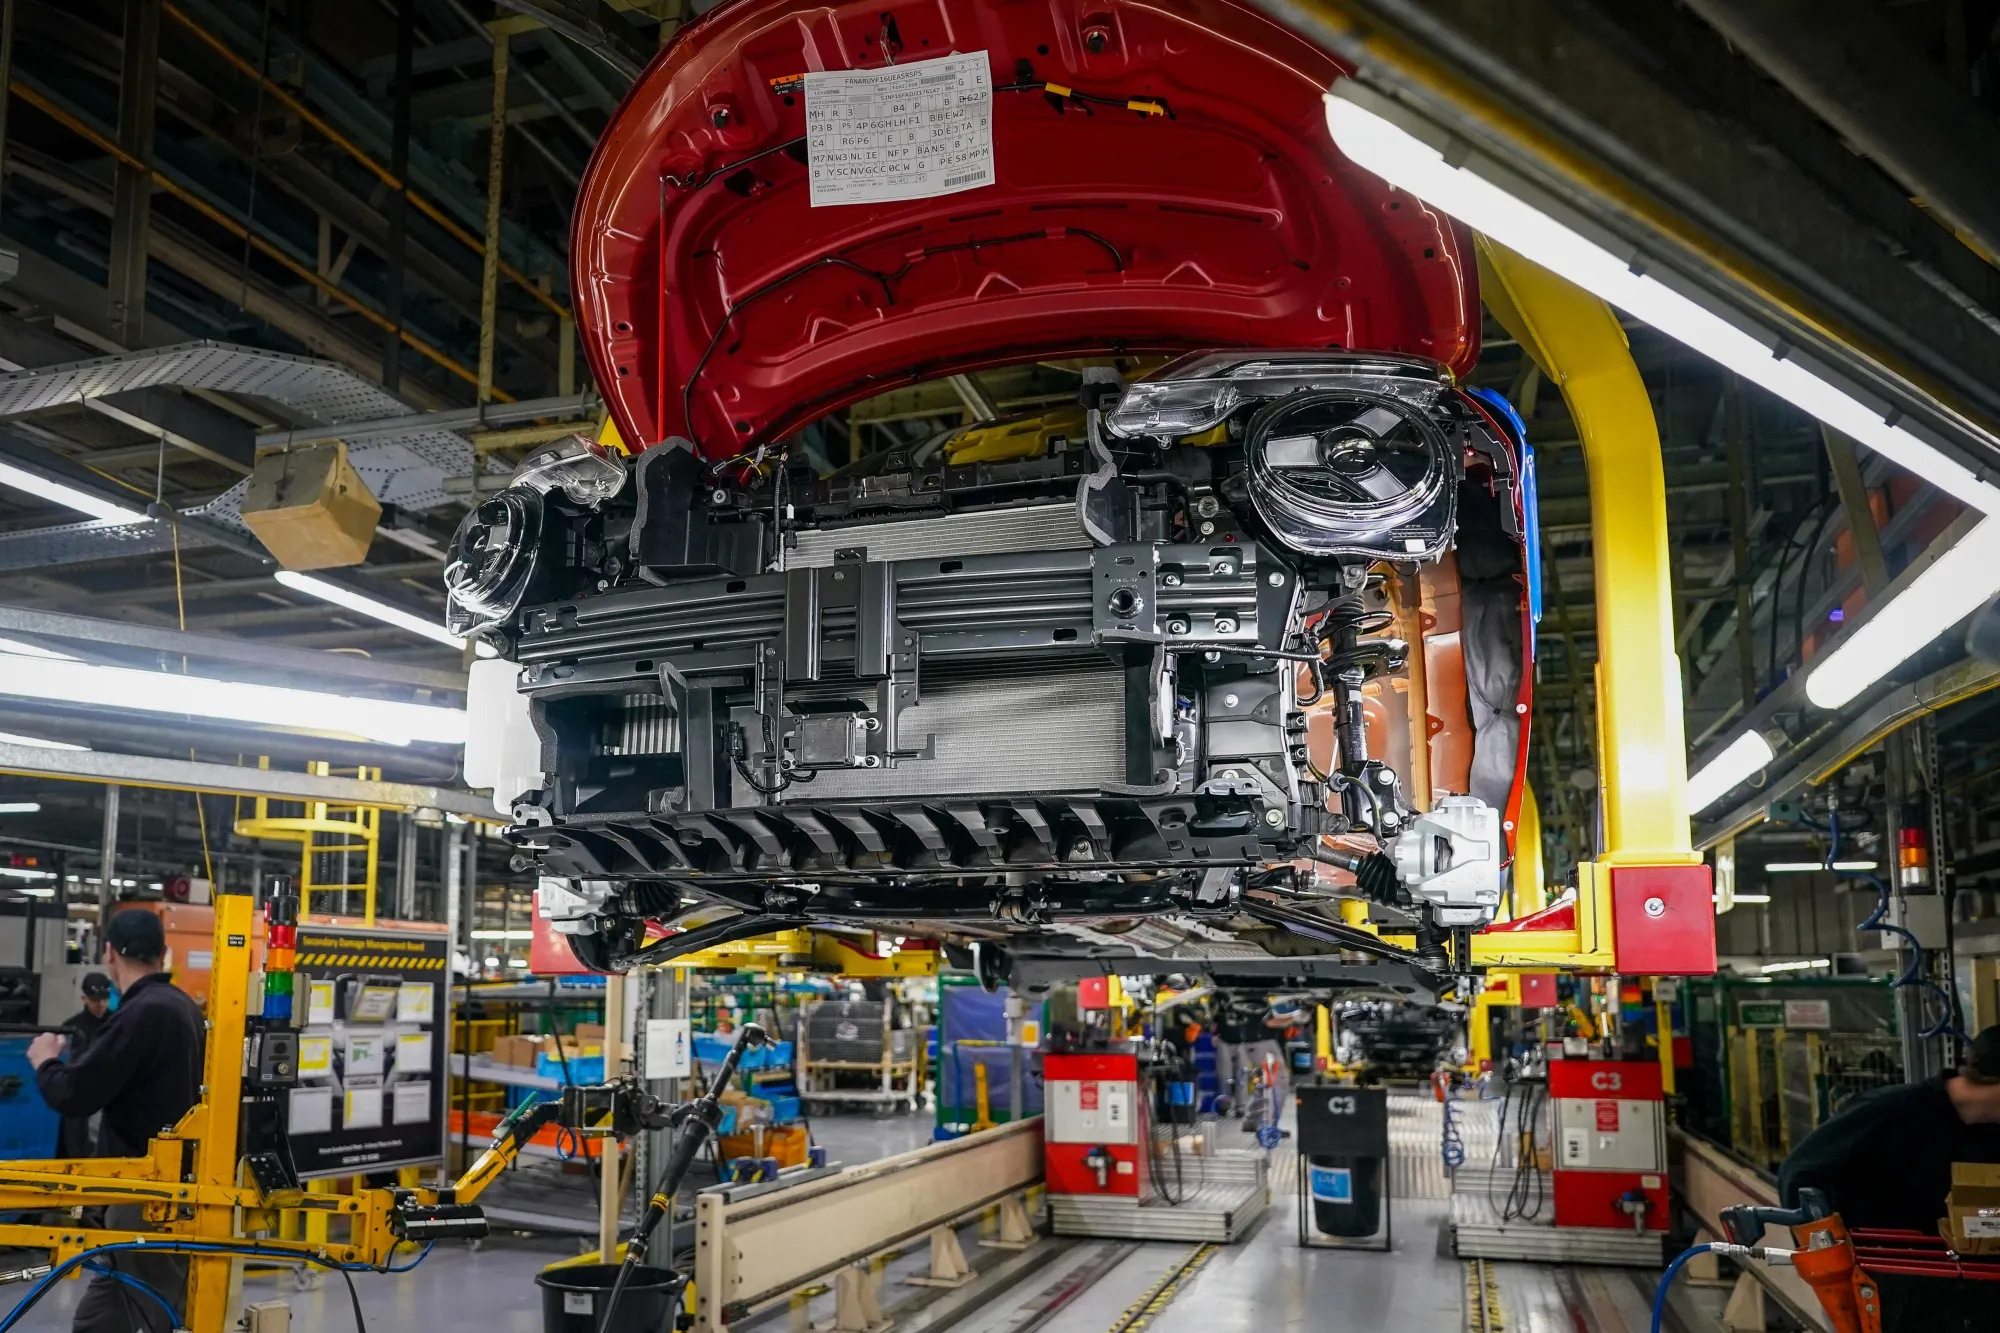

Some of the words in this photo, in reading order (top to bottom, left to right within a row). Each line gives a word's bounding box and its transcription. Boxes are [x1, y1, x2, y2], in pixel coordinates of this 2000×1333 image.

[976, 76, 982, 84] E
[893, 104, 905, 112] B4
[944, 98, 950, 106] B
[909, 116, 920, 124] F1
[812, 140, 824, 148] C4
[857, 137, 870, 145] P6
[888, 134, 892, 142] E
[909, 133, 914, 141] B
[903, 148, 909, 156] P
[814, 170, 820, 178] B
[919, 161, 925, 169] G
[1591, 1071, 1622, 1091] C3
[1327, 1096, 1356, 1115] C3
